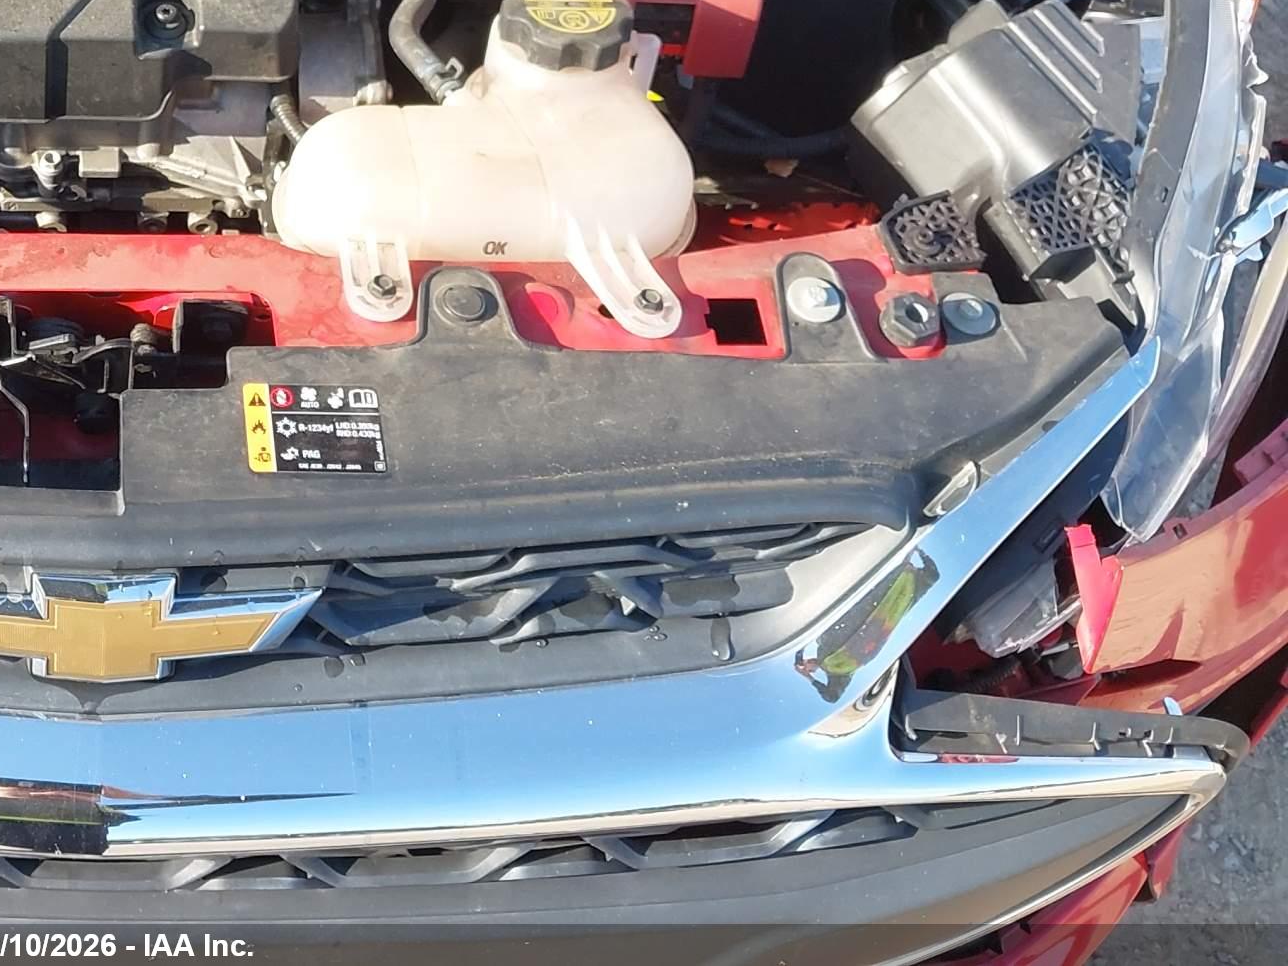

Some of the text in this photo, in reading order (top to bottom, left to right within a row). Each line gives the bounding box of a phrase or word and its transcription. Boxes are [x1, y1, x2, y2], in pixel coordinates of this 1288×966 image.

[483, 240, 508, 255] OK
[300, 401, 320, 409] AUTO
[302, 449, 321, 459] PAG
